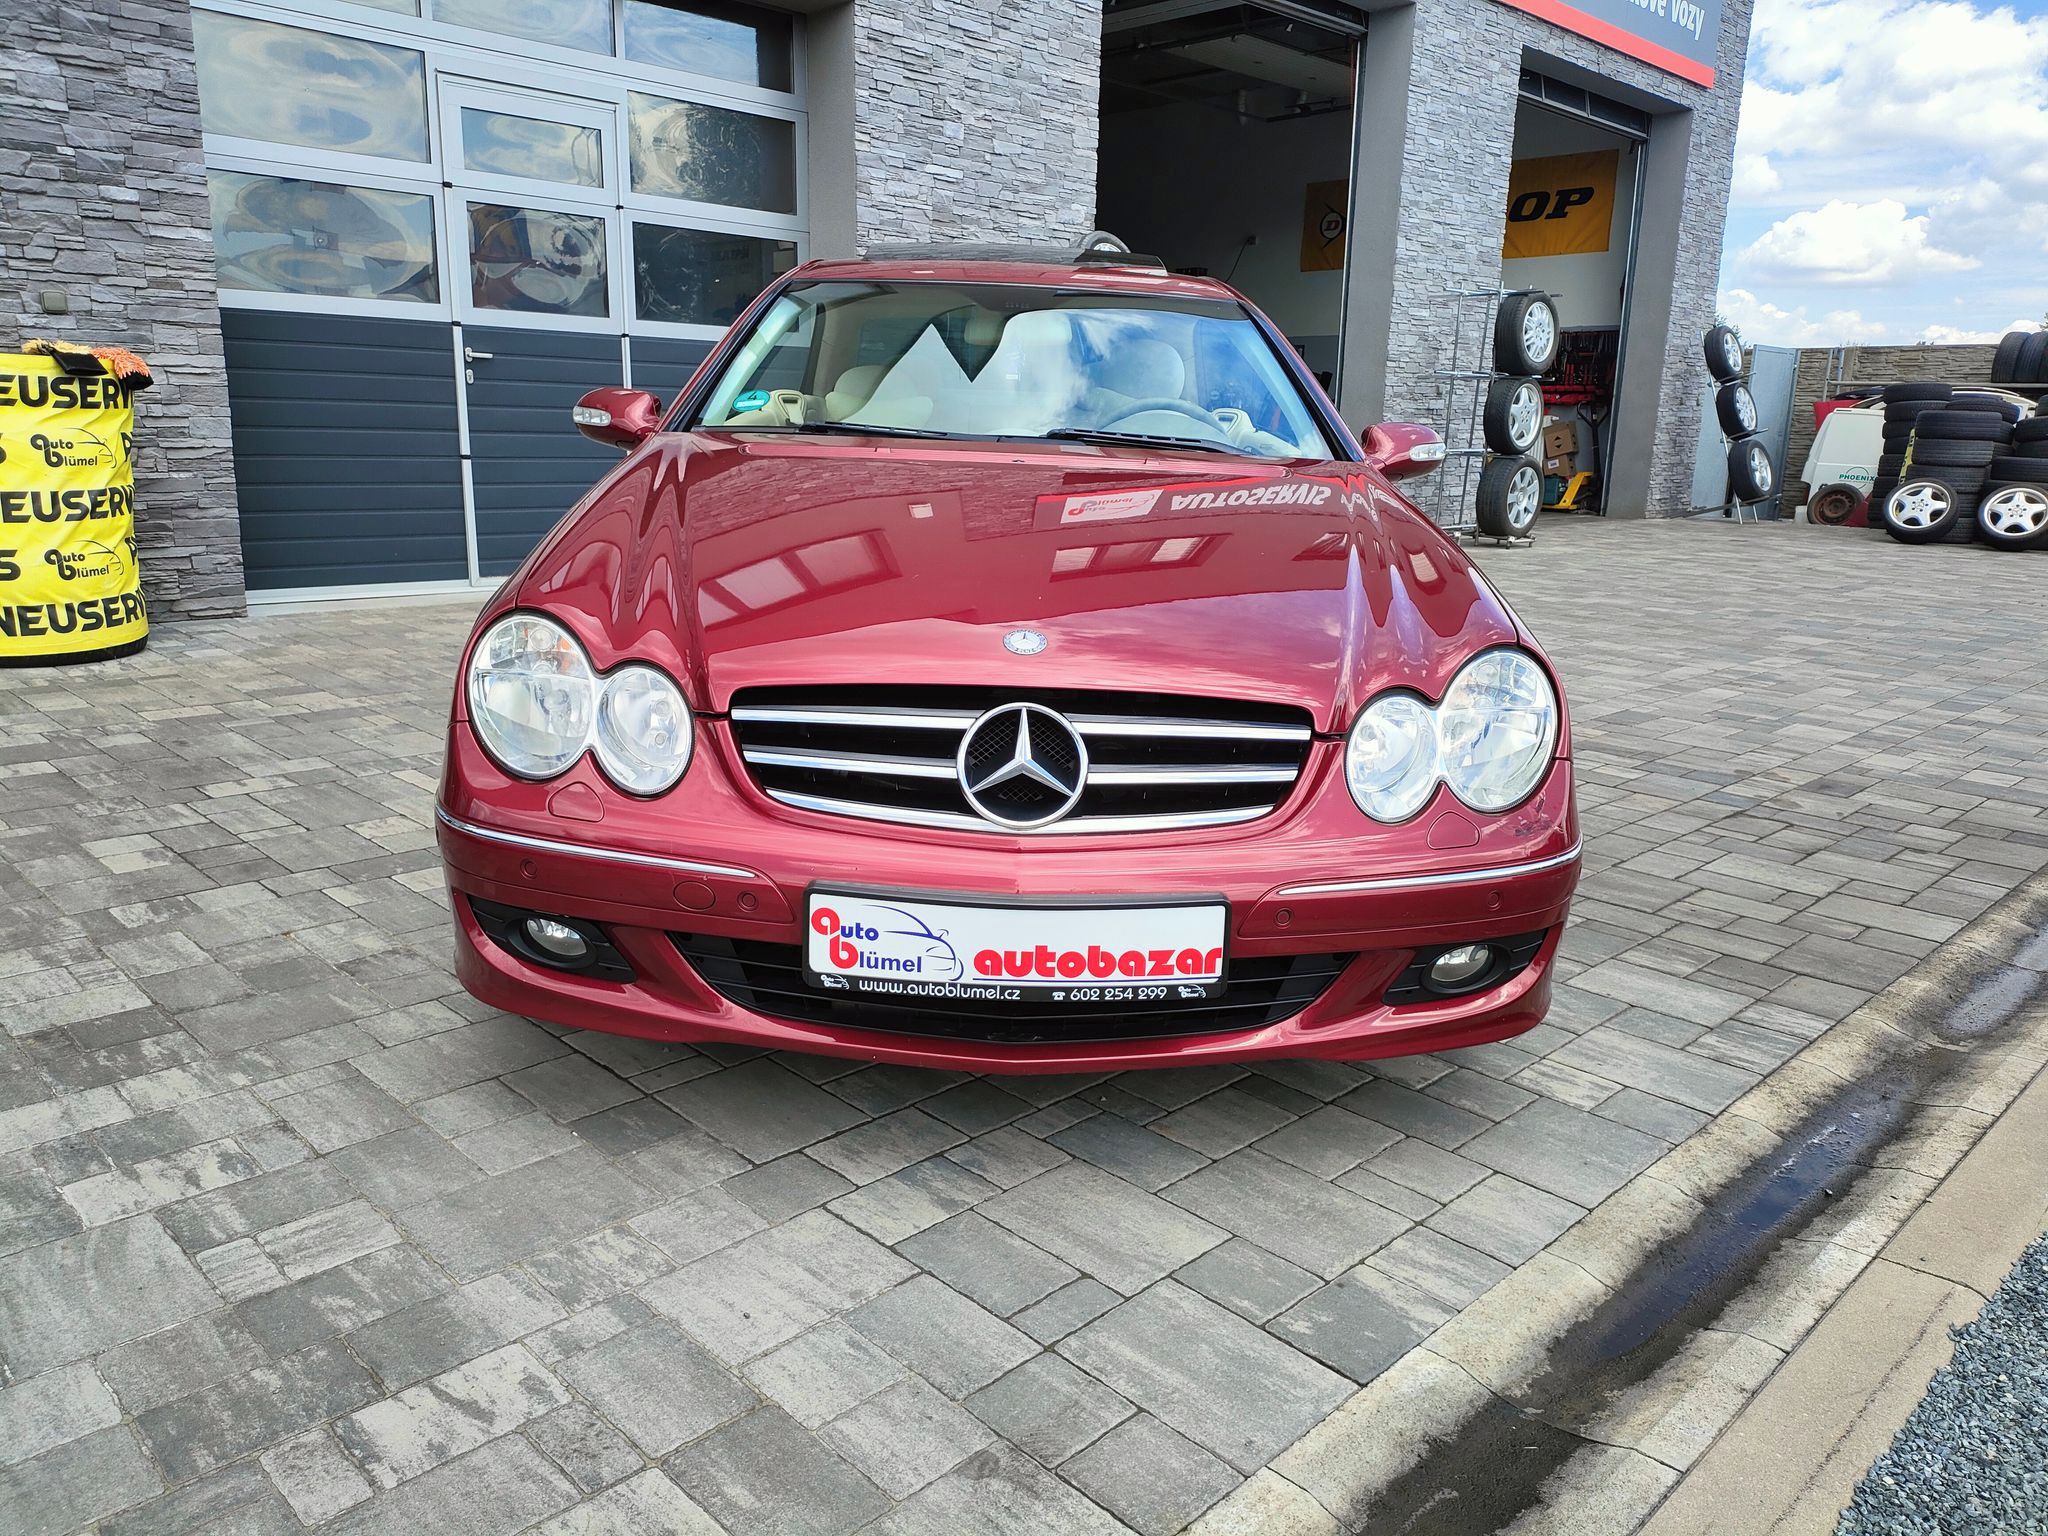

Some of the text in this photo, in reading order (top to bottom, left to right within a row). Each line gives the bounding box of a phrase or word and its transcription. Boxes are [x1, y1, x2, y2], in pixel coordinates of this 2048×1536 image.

[30, 434, 74, 451] auto
[44, 446, 98, 467] blümel
[1839, 474, 1876, 482] PHOENIX
[44, 549, 86, 565] auto
[57, 561, 110, 581] blümel
[811, 907, 879, 941] auto
[829, 934, 922, 973] blümel
[973, 945, 1222, 978] autobazar
[859, 979, 1021, 1000] www.autoblumel.cz
[1070, 988, 1100, 1001] 602
[1104, 988, 1134, 1001] 254
[1138, 987, 1167, 1000] 299
